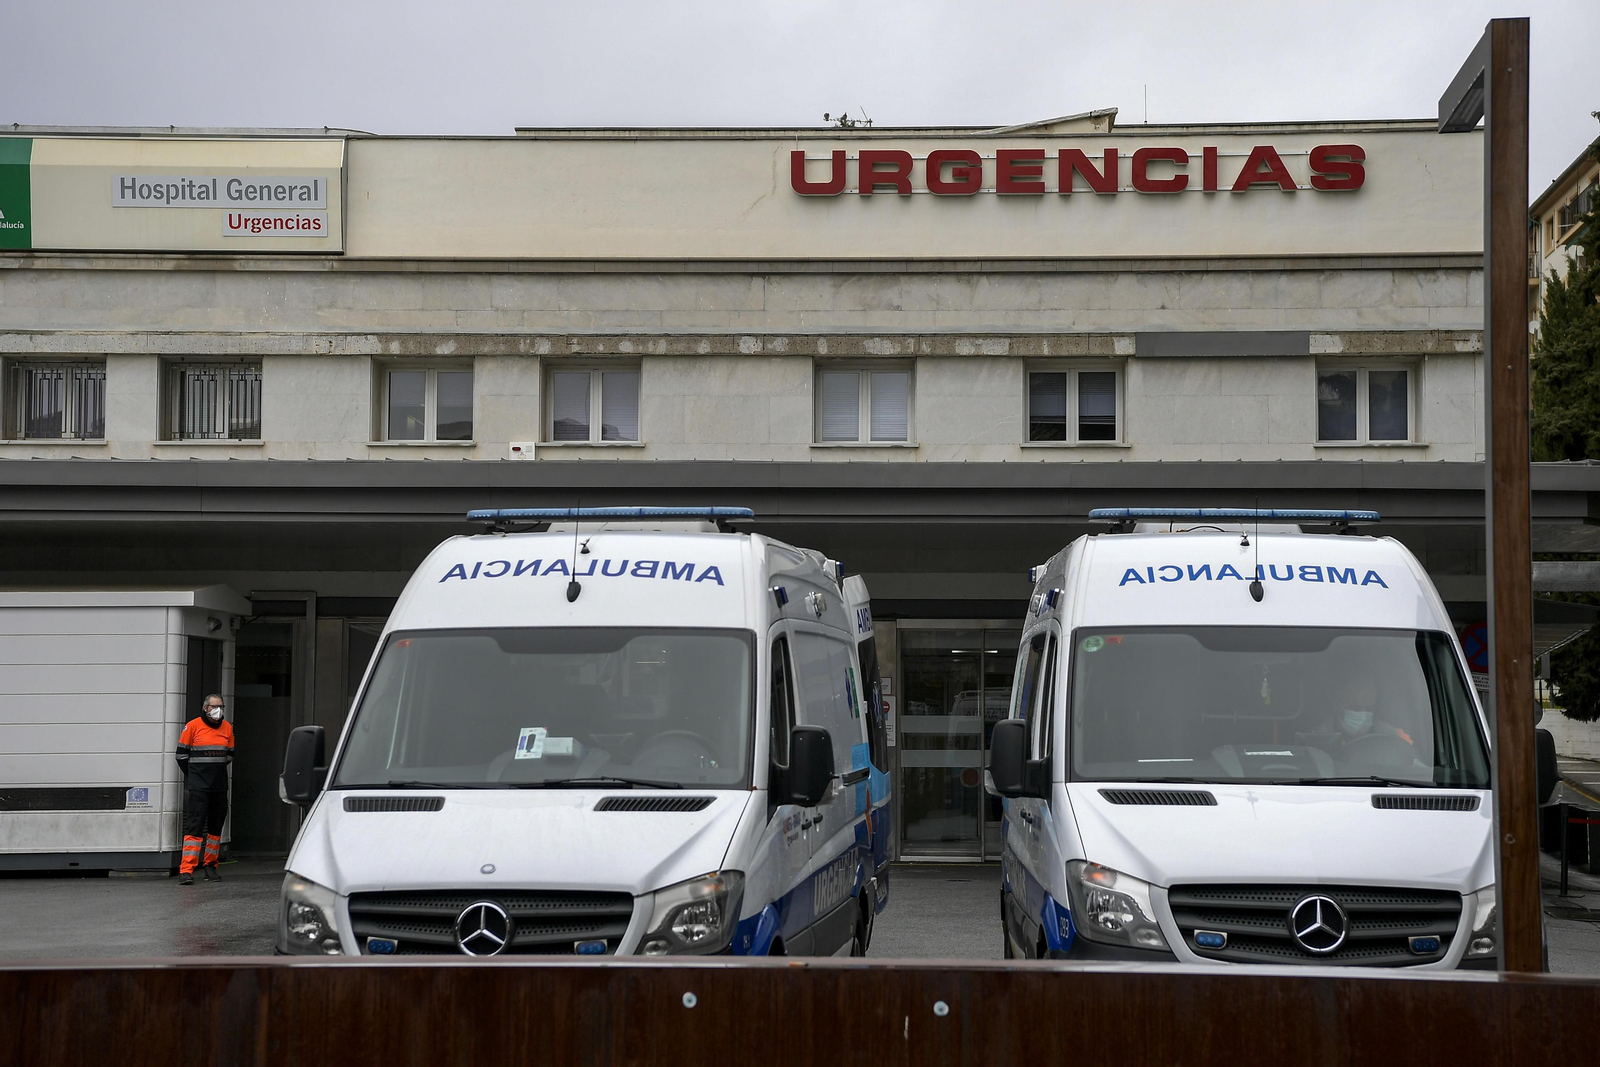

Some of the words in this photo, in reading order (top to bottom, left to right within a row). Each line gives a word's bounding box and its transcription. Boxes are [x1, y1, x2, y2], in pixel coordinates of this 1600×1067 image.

[790, 144, 1366, 196] URGENCIAS
[120, 177, 217, 205] Hospital
[226, 178, 319, 202] General
[228, 213, 322, 234] Urgencias
